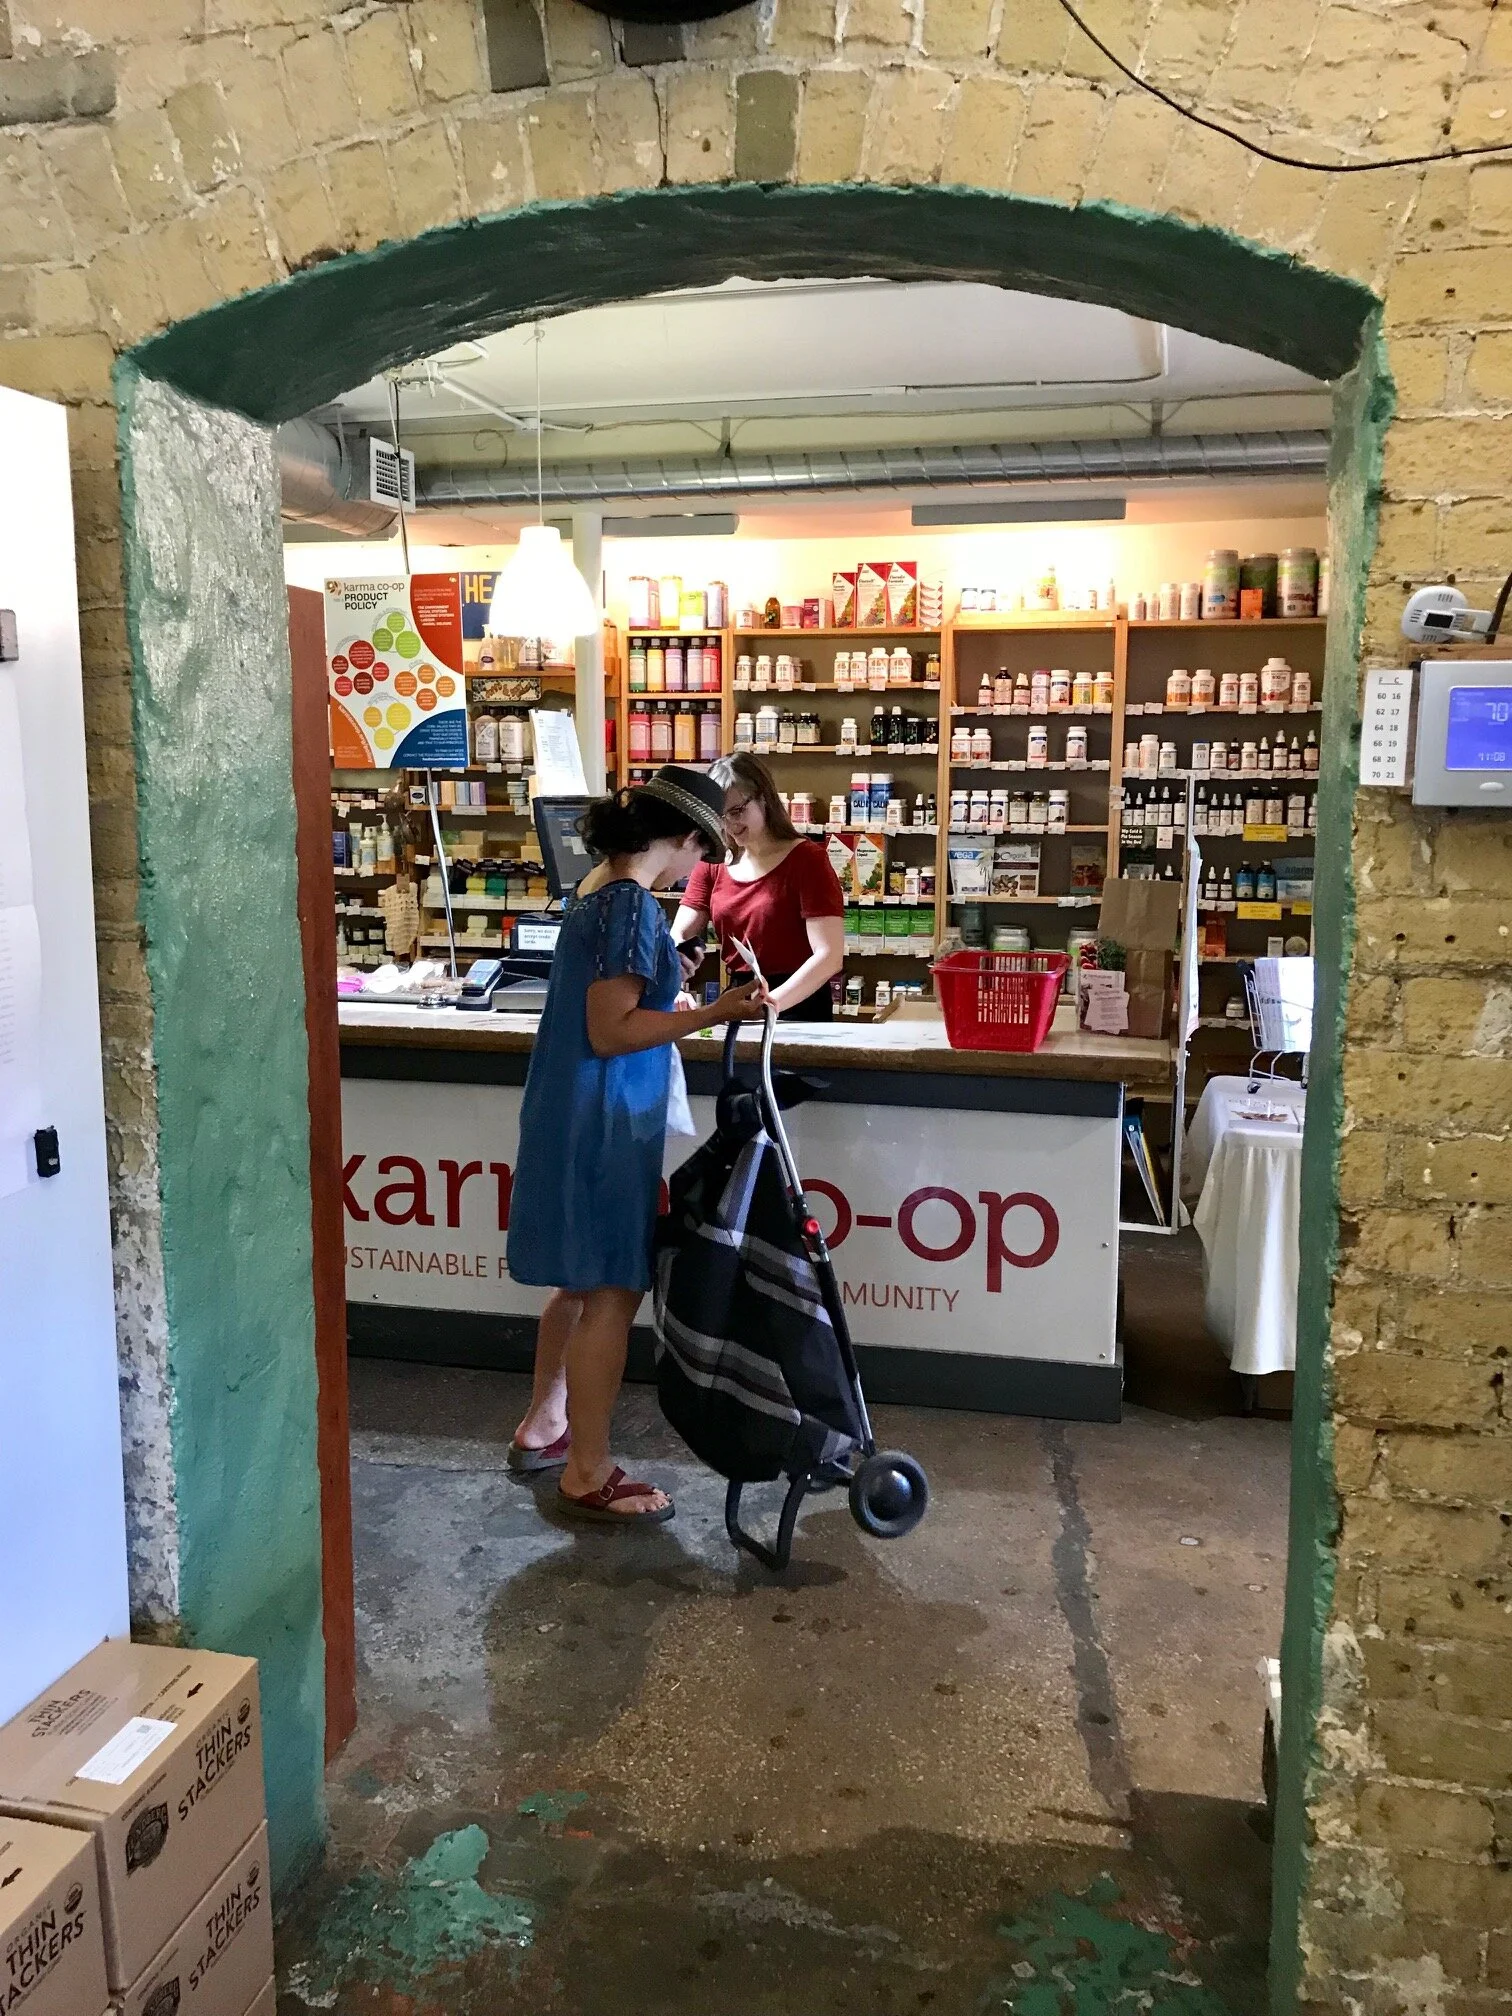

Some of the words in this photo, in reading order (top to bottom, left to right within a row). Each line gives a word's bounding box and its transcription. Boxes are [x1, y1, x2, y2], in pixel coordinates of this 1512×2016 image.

[343, 582, 375, 592] karma
[377, 582, 405, 593] co-op
[344, 592, 388, 602] PRODUCT
[464, 574, 493, 604] HE
[344, 601, 378, 610] POLICY
[1394, 676, 1400, 685] C
[1377, 692, 1387, 700] 60
[1392, 692, 1401, 700] 16
[1375, 708, 1385, 716] 62
[1390, 708, 1400, 716] 17
[1485, 702, 1509, 722] 70
[872, 800, 887, 808] CAL
[342, 1154, 518, 1232] kar
[786, 1178, 1060, 1294] o-op
[344, 1246, 488, 1278] STAINABLE
[842, 1280, 960, 1312] MUNITY
[28, 1699, 62, 1723] THIN
[31, 1688, 91, 1738] STACKERS
[195, 1717, 233, 1770] THIN
[177, 1724, 252, 1821] STACKERS
[206, 1883, 241, 1938] THIN
[6, 1909, 56, 1976] THIN
[188, 1886, 261, 1991] STACKERS
[0, 1910, 86, 2016] TACKERS
